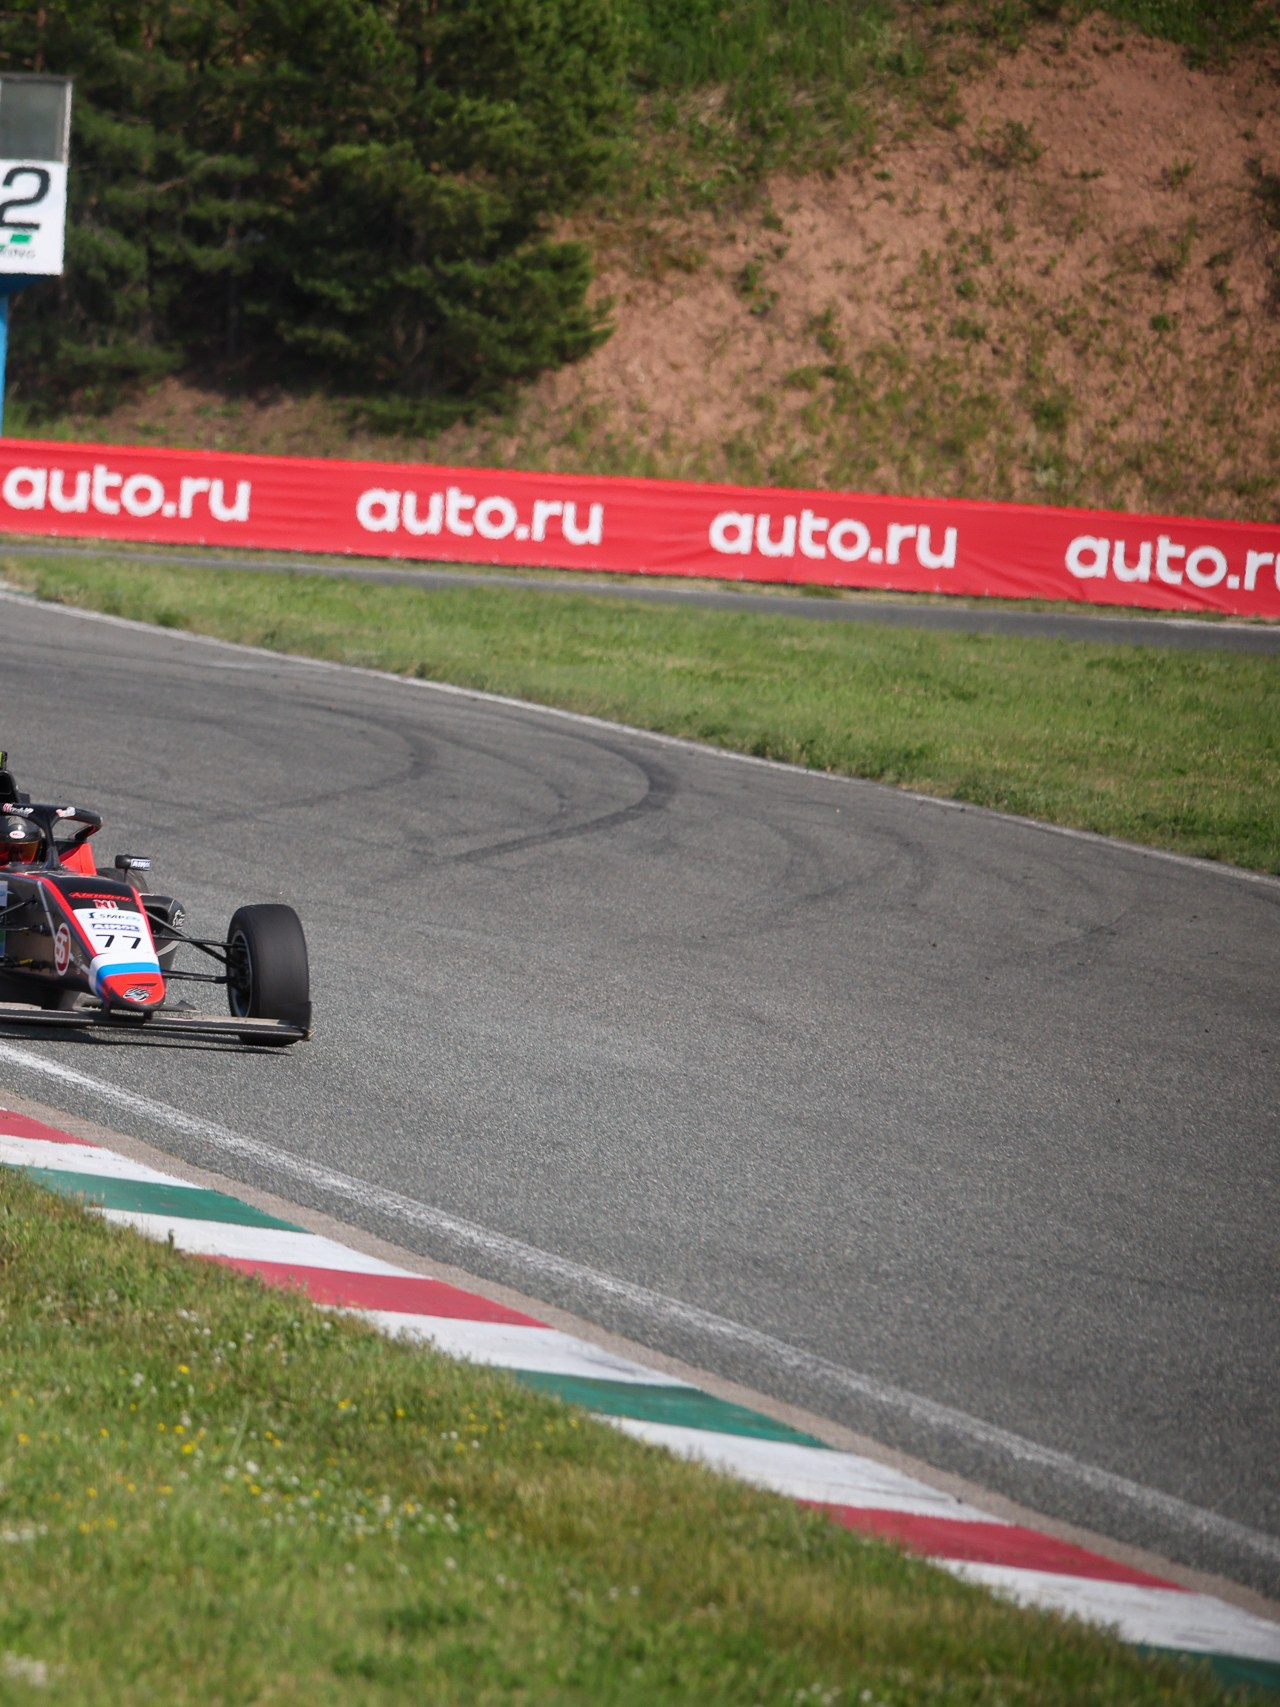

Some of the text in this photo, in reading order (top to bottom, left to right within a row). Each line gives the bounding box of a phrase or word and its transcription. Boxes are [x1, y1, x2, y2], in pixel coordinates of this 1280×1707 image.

[2, 464, 251, 522] auto.ru
[356, 487, 603, 546] auto.ru
[709, 509, 957, 569] auto.ru
[1065, 535, 1280, 591] auto.r
[96, 934, 141, 949] 77
